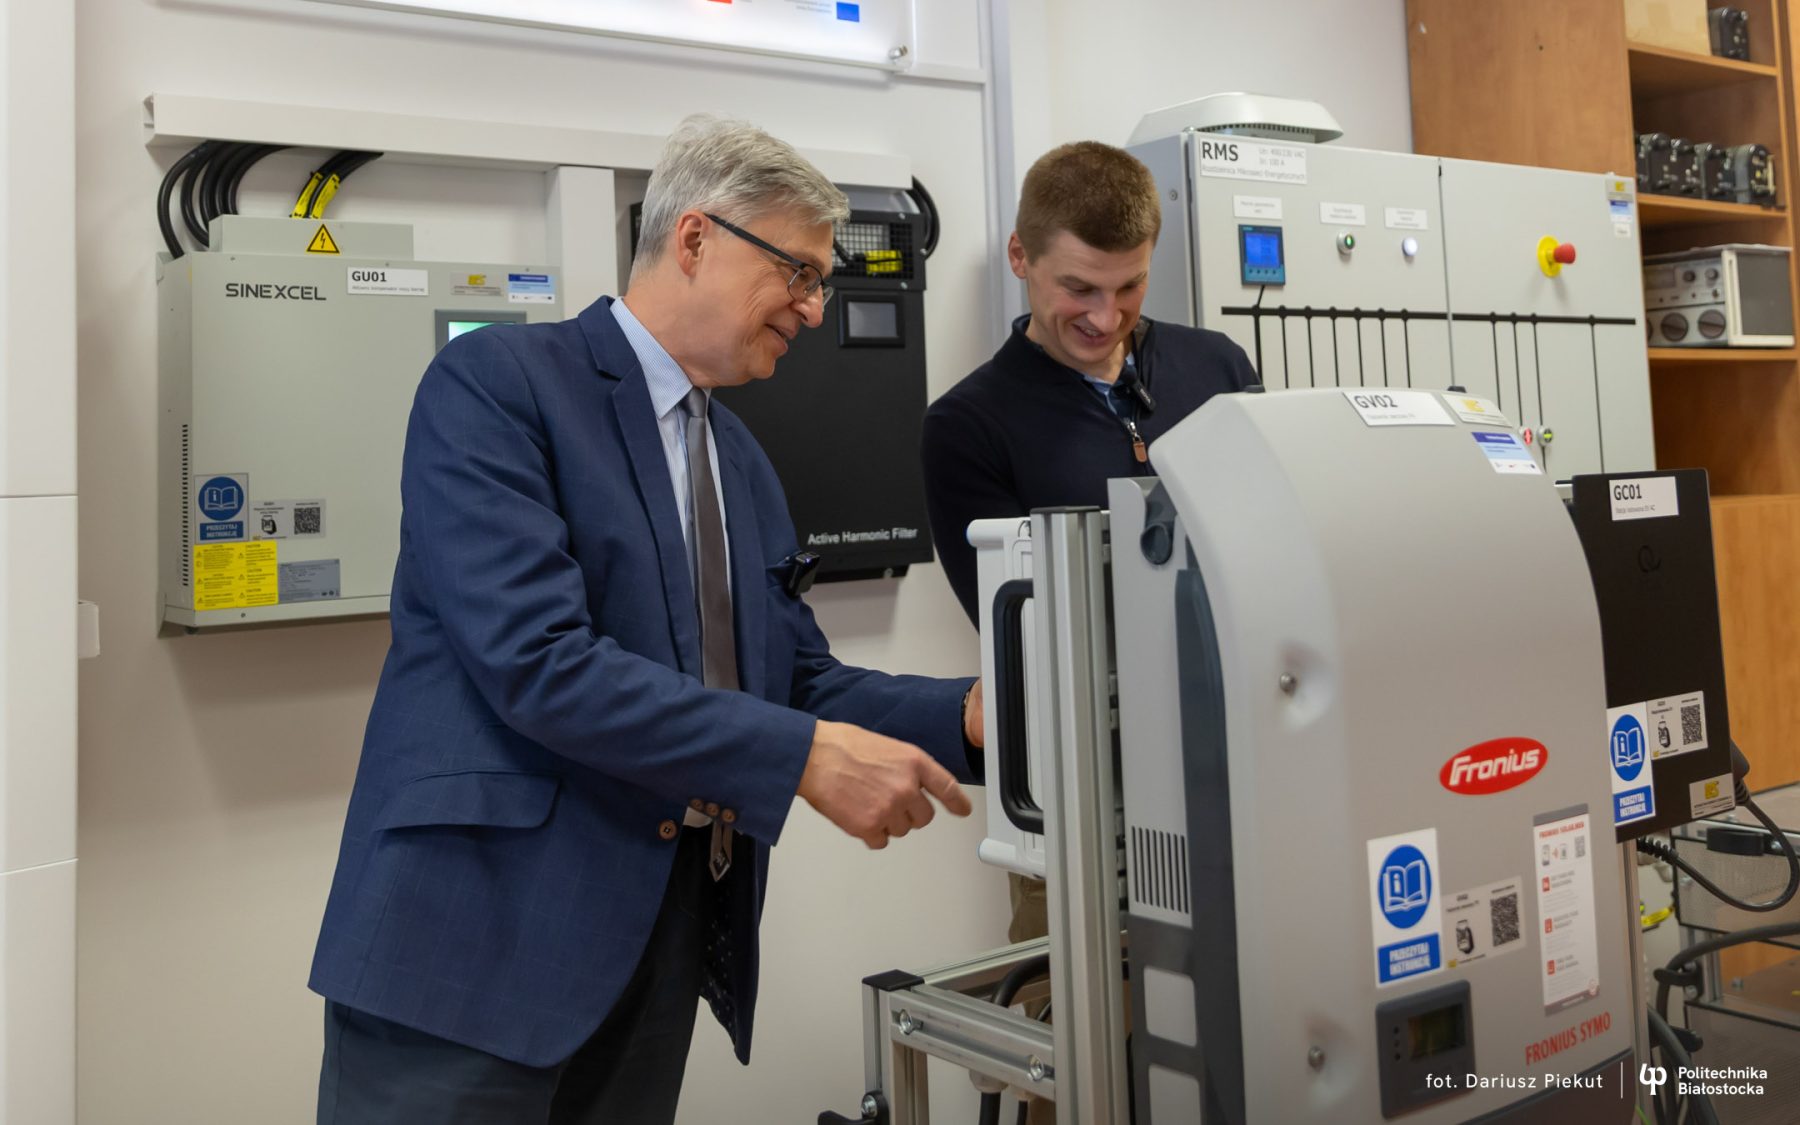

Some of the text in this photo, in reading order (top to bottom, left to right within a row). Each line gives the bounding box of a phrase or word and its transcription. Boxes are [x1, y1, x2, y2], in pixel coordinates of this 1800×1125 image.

[1202, 141, 1239, 162] RMS
[351, 270, 387, 283] GU01
[225, 283, 327, 301] SINEXCEL
[1353, 394, 1399, 409] GV02
[1613, 483, 1643, 501] GC01
[807, 527, 918, 546] Active Harmonic Filter
[1448, 748, 1540, 786] Fronius
[1525, 1011, 1611, 1066] FRONIUS SYMO
